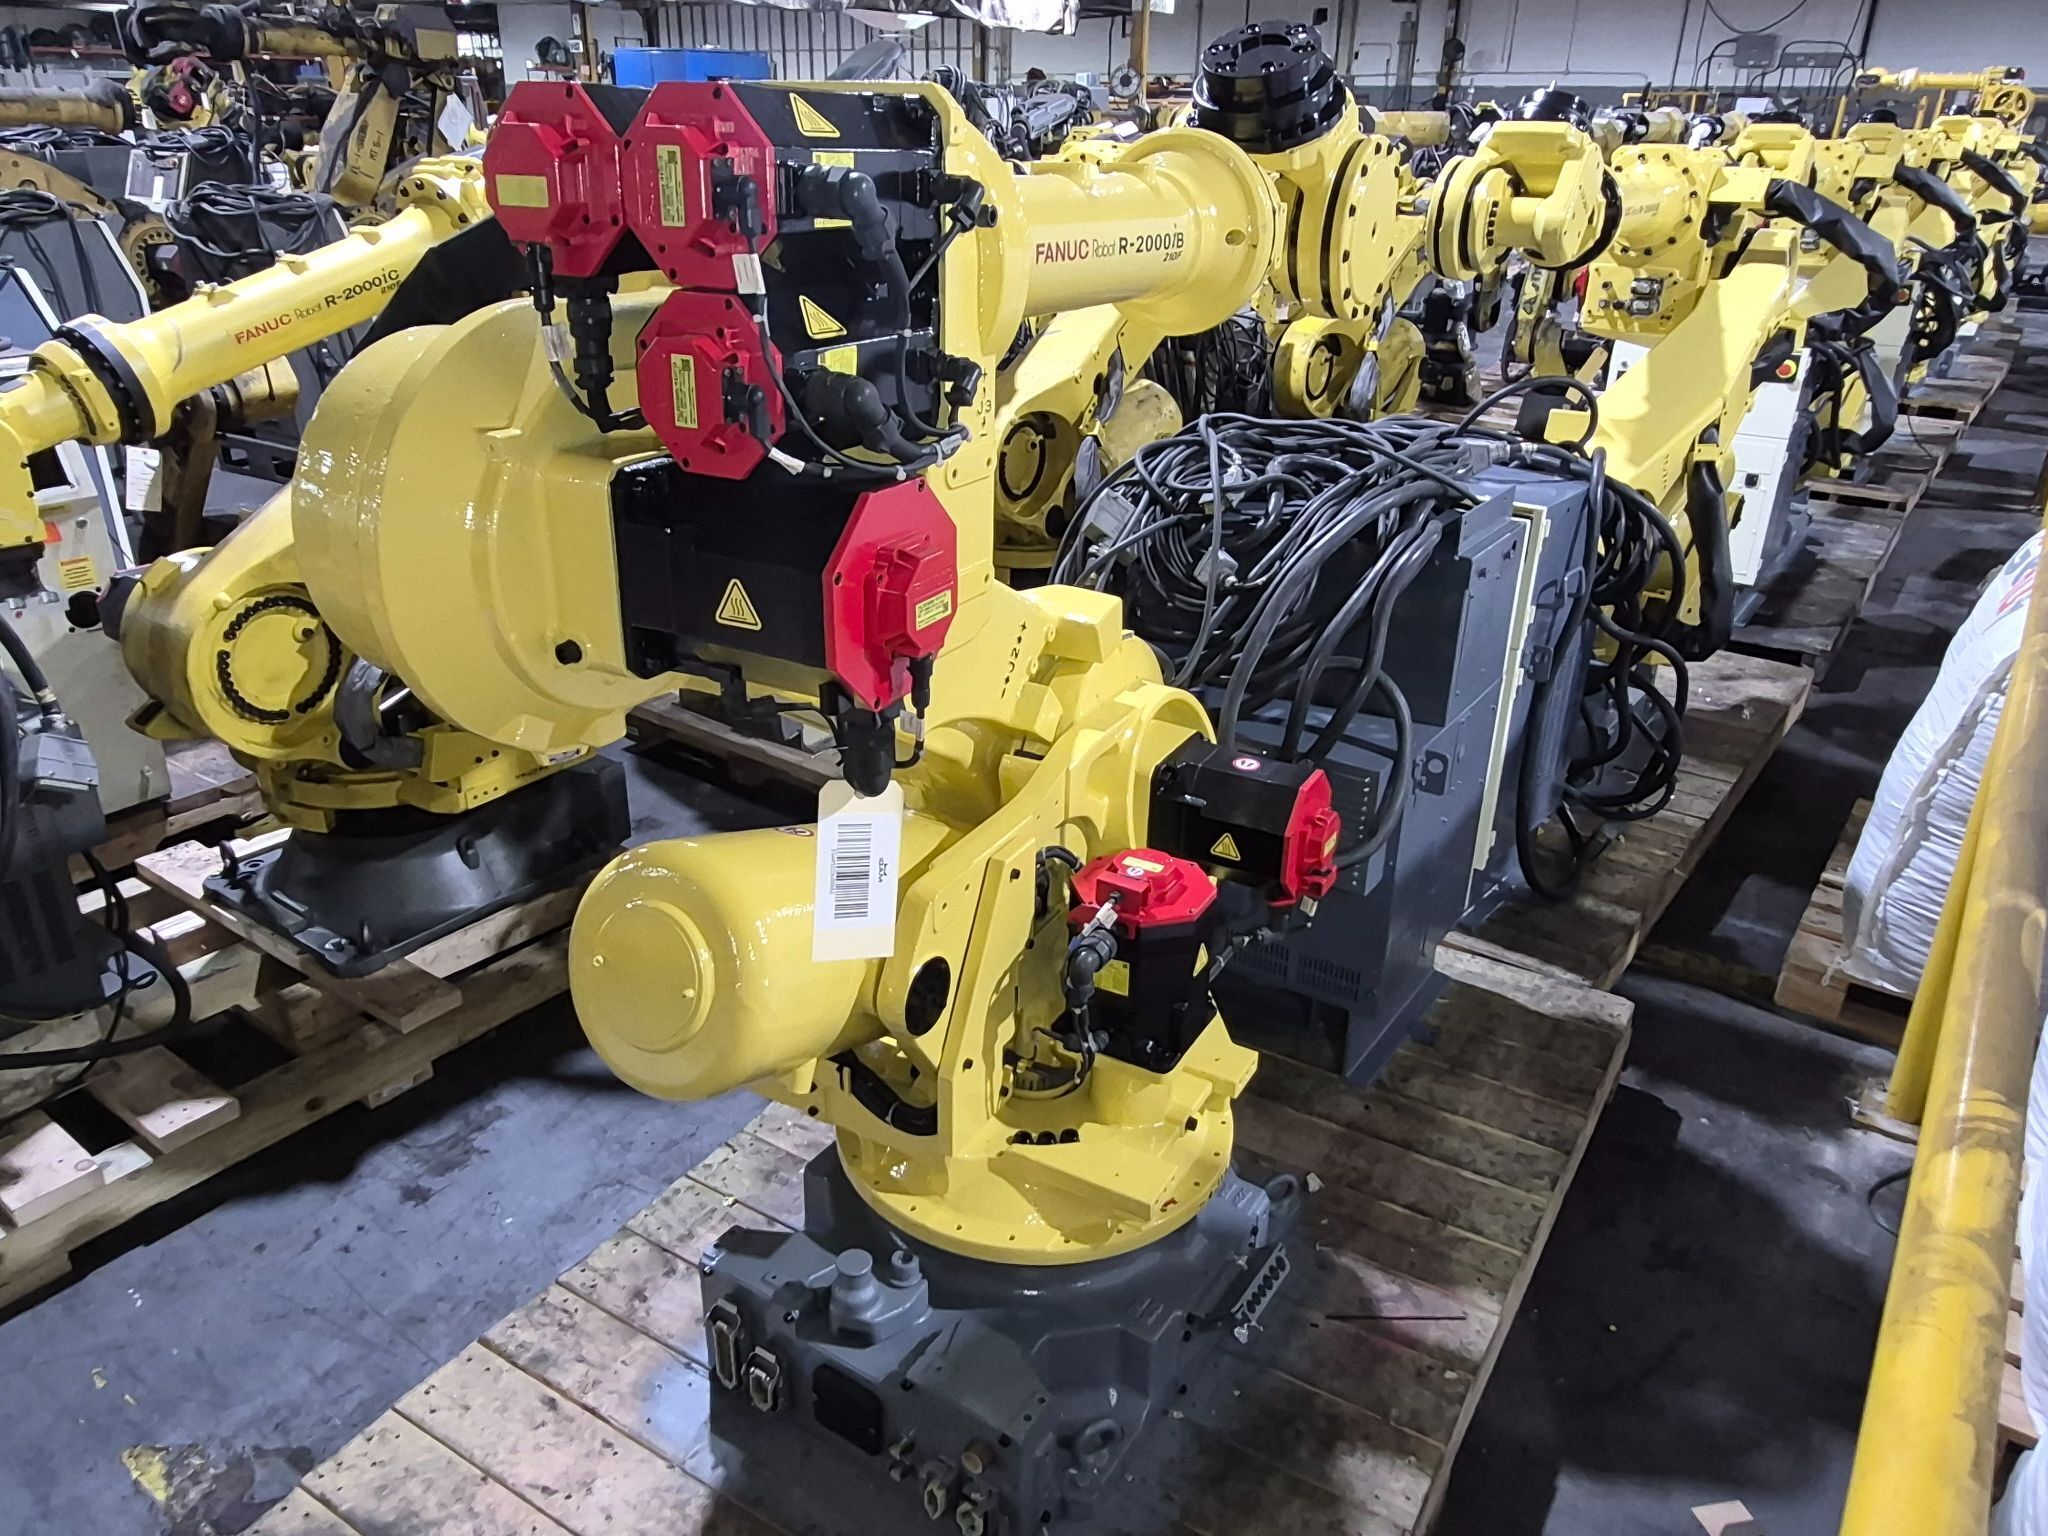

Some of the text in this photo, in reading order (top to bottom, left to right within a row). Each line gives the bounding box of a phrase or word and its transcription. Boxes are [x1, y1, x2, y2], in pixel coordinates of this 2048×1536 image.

[1035, 239, 1090, 264] FANUC
[1092, 238, 1116, 259] Robot
[1162, 250, 1183, 262] 210F
[234, 313, 292, 345] FANUC
[294, 303, 323, 320] Robot
[976, 399, 992, 415] J3
